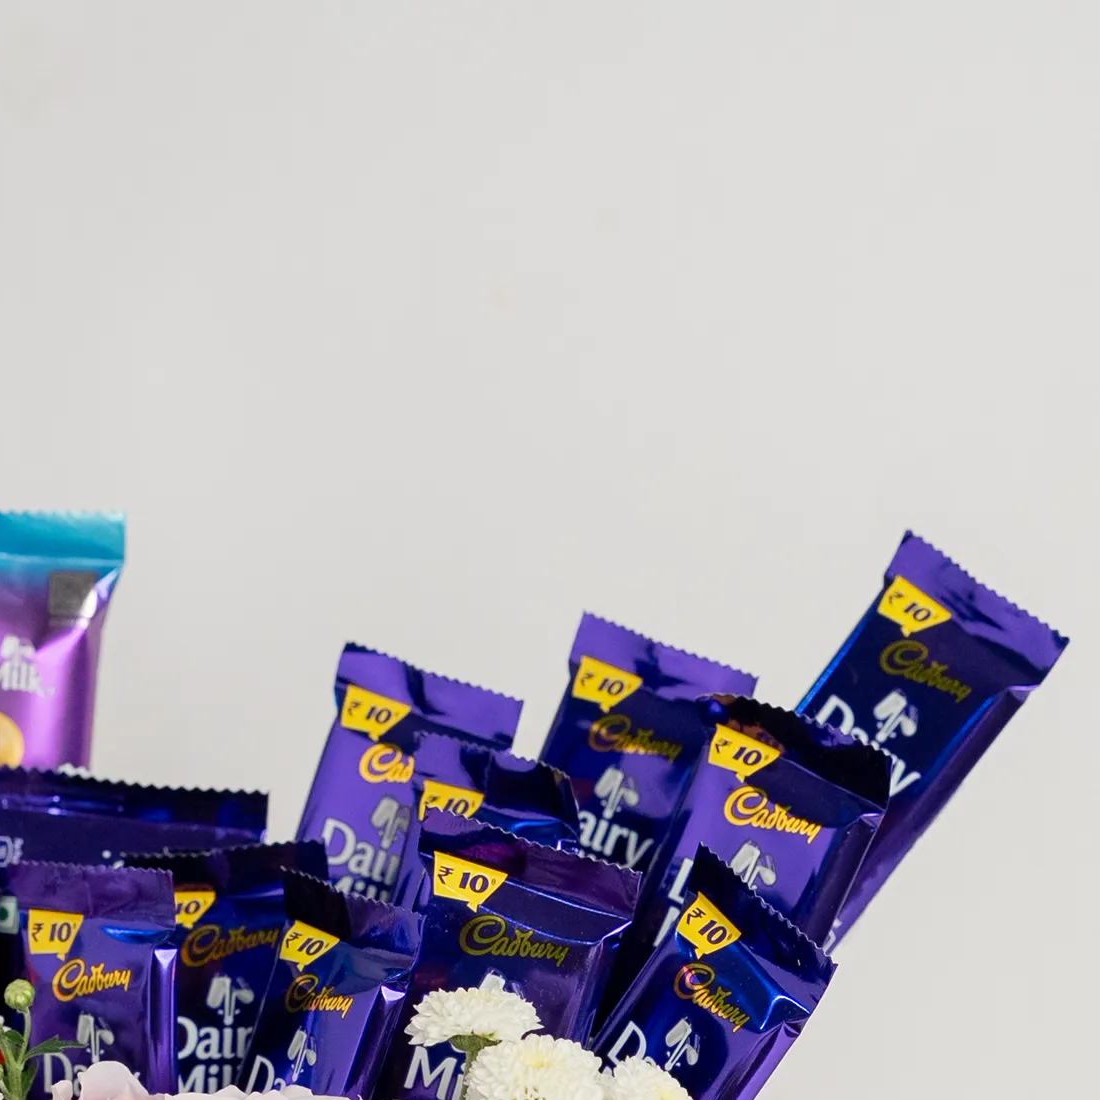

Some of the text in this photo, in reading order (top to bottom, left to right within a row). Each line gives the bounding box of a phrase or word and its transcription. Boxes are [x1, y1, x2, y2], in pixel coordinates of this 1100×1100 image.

[879, 640, 973, 702] Cadbury
[588, 715, 685, 763] Cadbury
[579, 809, 656, 868] airy
[724, 784, 822, 845] Cadbury
[181, 924, 280, 966] Cadbury
[459, 914, 570, 967] Cadbury
[52, 958, 132, 1002] Cadbury
[285, 974, 355, 1019] Cadbury
[673, 962, 752, 1032] Cadbury
